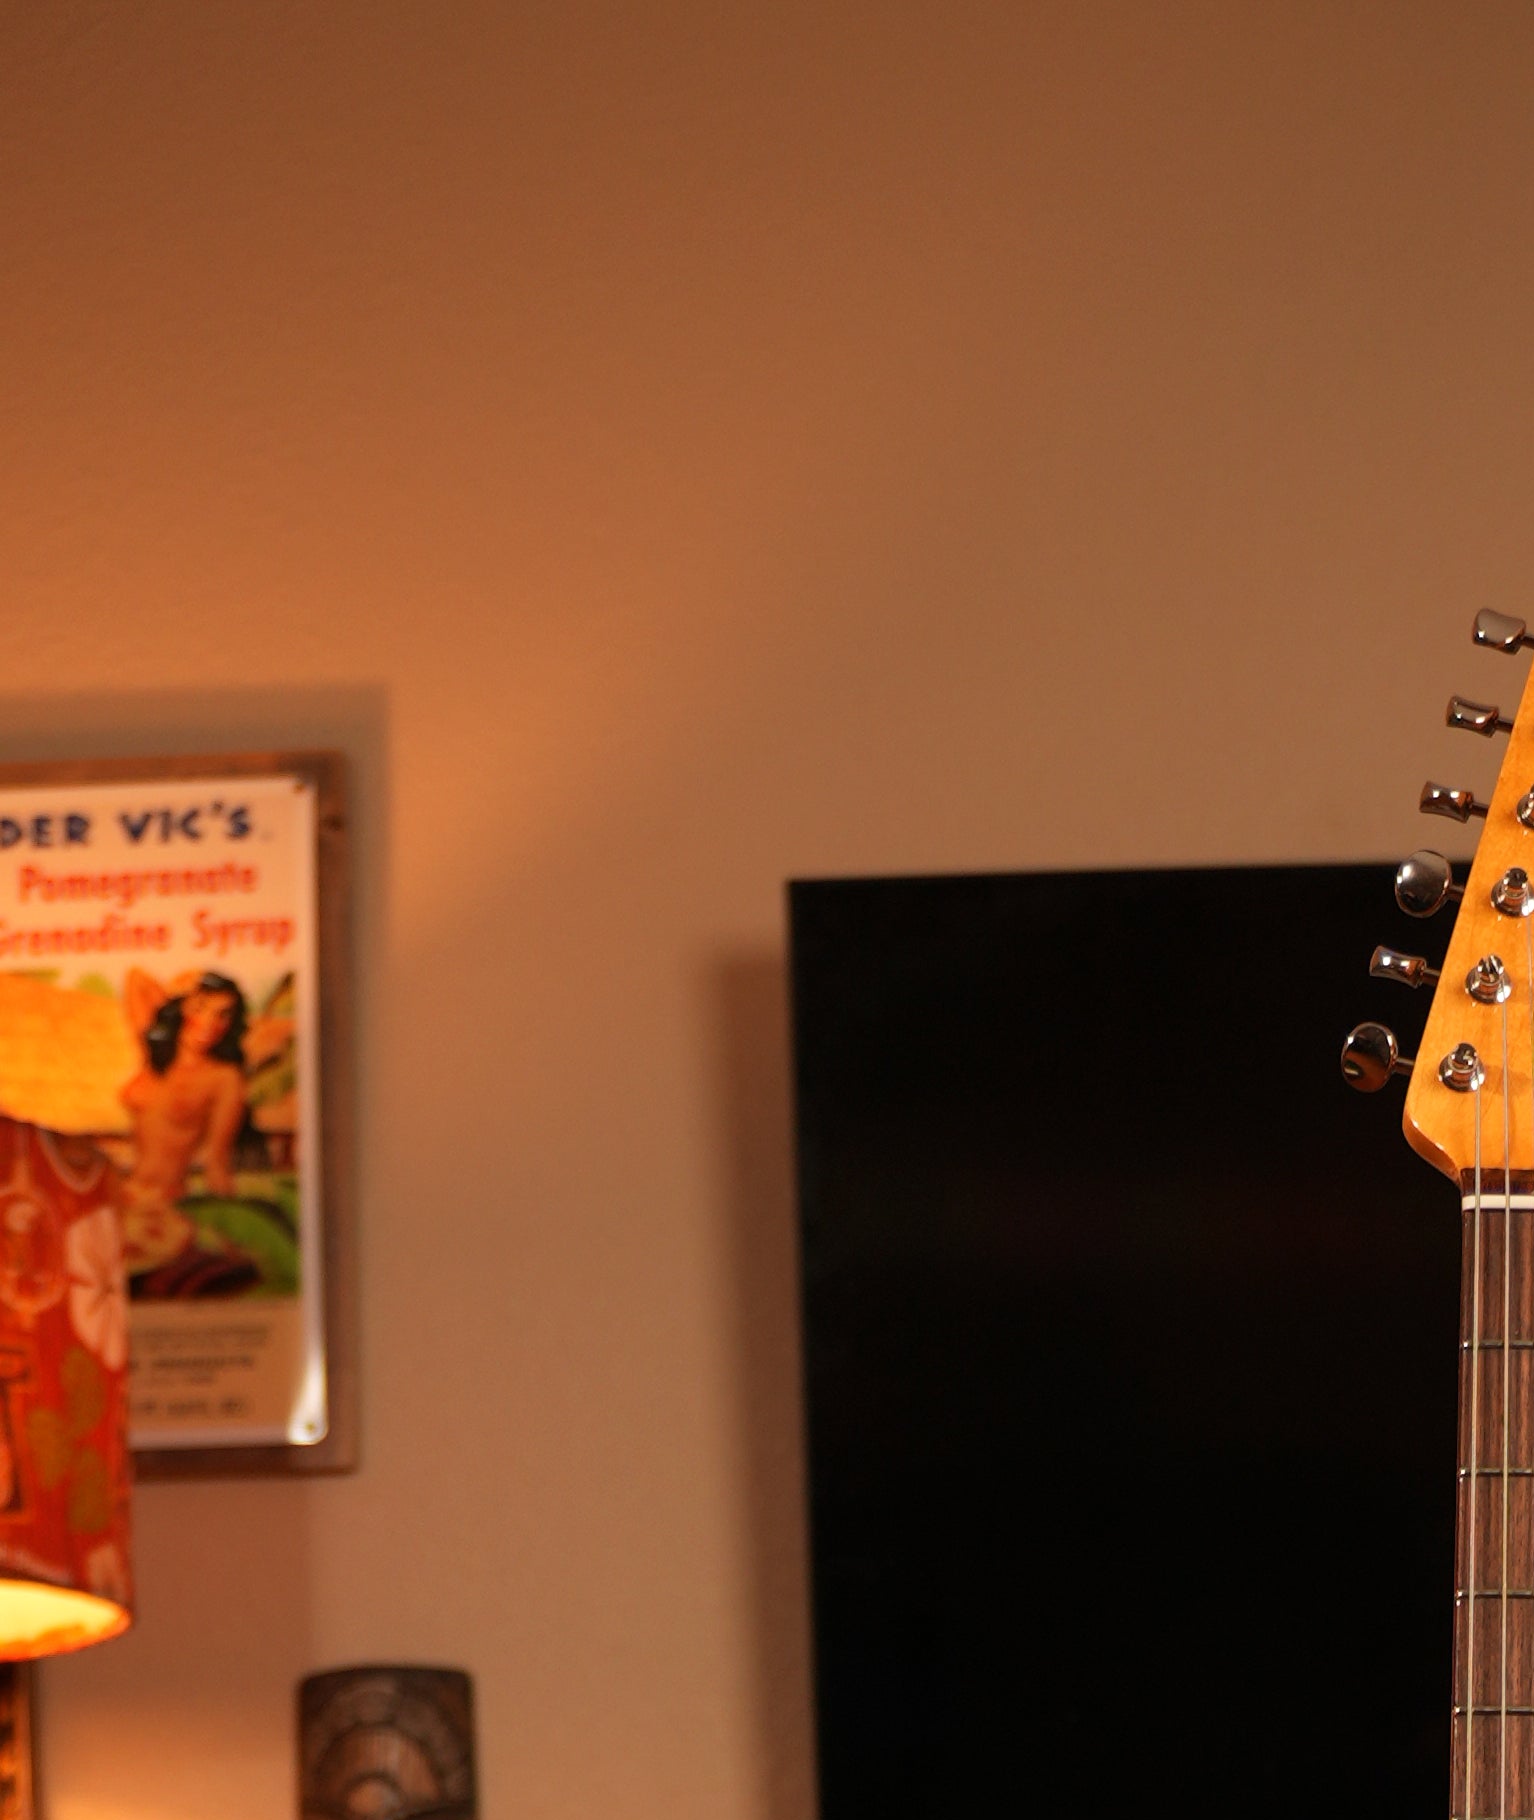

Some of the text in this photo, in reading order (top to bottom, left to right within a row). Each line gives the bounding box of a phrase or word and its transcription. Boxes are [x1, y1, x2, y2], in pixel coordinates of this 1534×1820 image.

[118, 801, 251, 843] VIC'S
[19, 865, 257, 907] Pomegranate
[193, 907, 297, 957] Syrup
